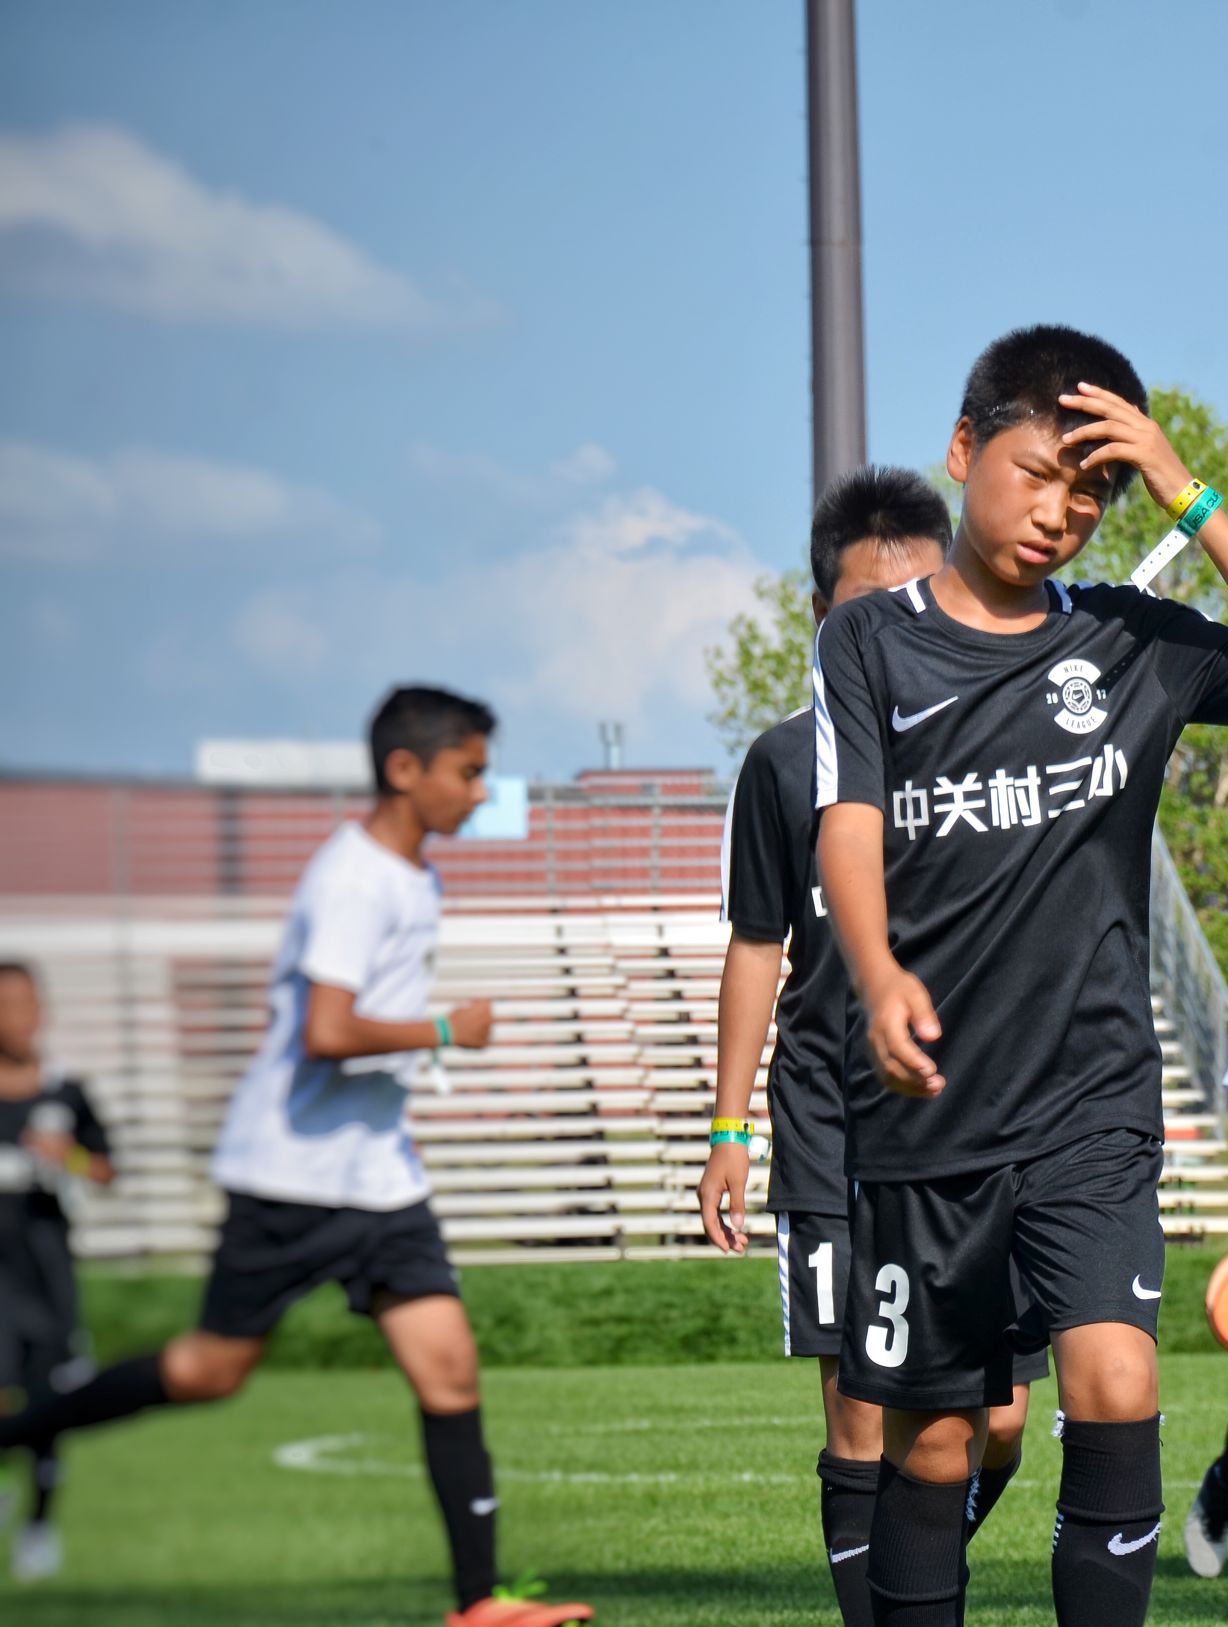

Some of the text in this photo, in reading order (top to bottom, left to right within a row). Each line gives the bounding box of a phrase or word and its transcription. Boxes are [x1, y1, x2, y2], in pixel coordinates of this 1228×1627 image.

[1189, 507, 1210, 529] USA
[1066, 716, 1096, 728] LEAGUE
[892, 743, 1129, 841] 中关村三小
[808, 1241, 835, 1325] 1
[865, 1263, 910, 1368] 3
